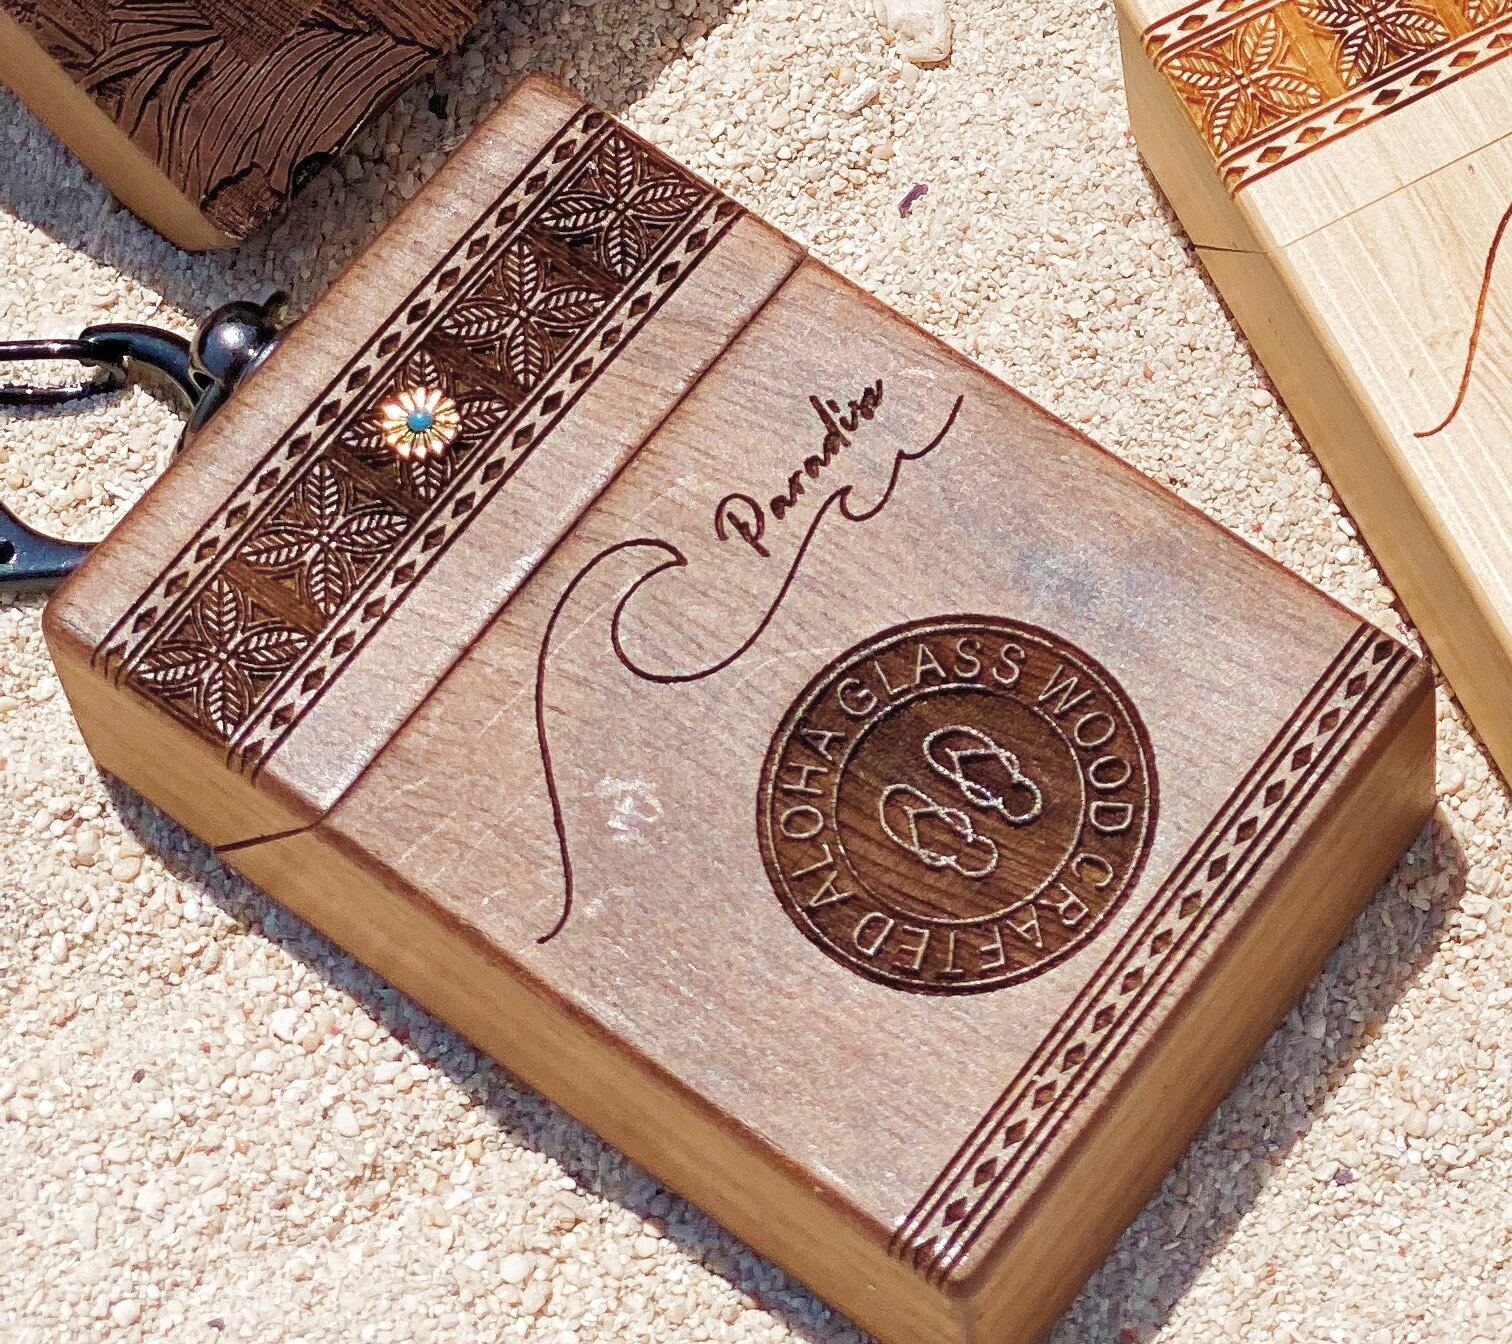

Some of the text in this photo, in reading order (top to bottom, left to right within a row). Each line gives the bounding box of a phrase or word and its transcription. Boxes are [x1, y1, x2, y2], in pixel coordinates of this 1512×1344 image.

[715, 379, 883, 558] Paradise
[780, 638, 1134, 974] ALOHA GLASS WOOD CRAFTED
